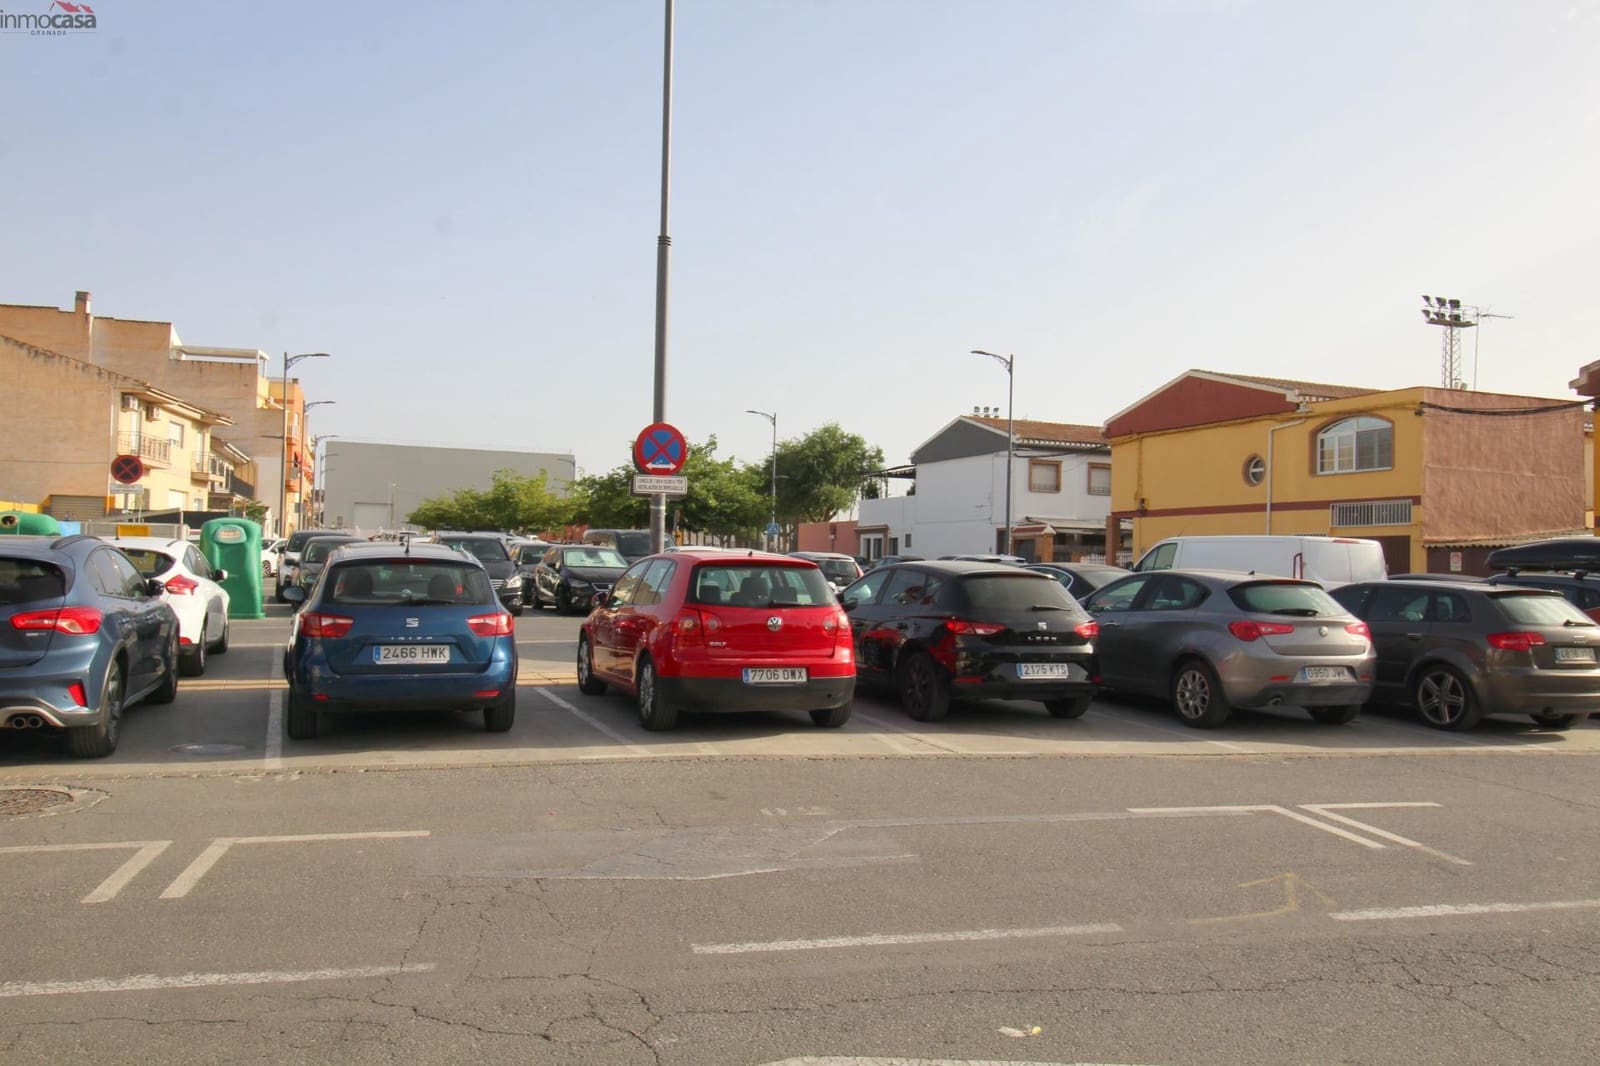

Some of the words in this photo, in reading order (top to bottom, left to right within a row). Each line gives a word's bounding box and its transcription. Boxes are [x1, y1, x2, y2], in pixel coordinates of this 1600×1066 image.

[383, 647, 417, 659] 2466
[421, 647, 447, 659] HWK
[751, 669, 779, 680] 7706
[783, 669, 804, 680] DWX
[1024, 664, 1048, 675] 2175
[1048, 664, 1067, 675] KTS
